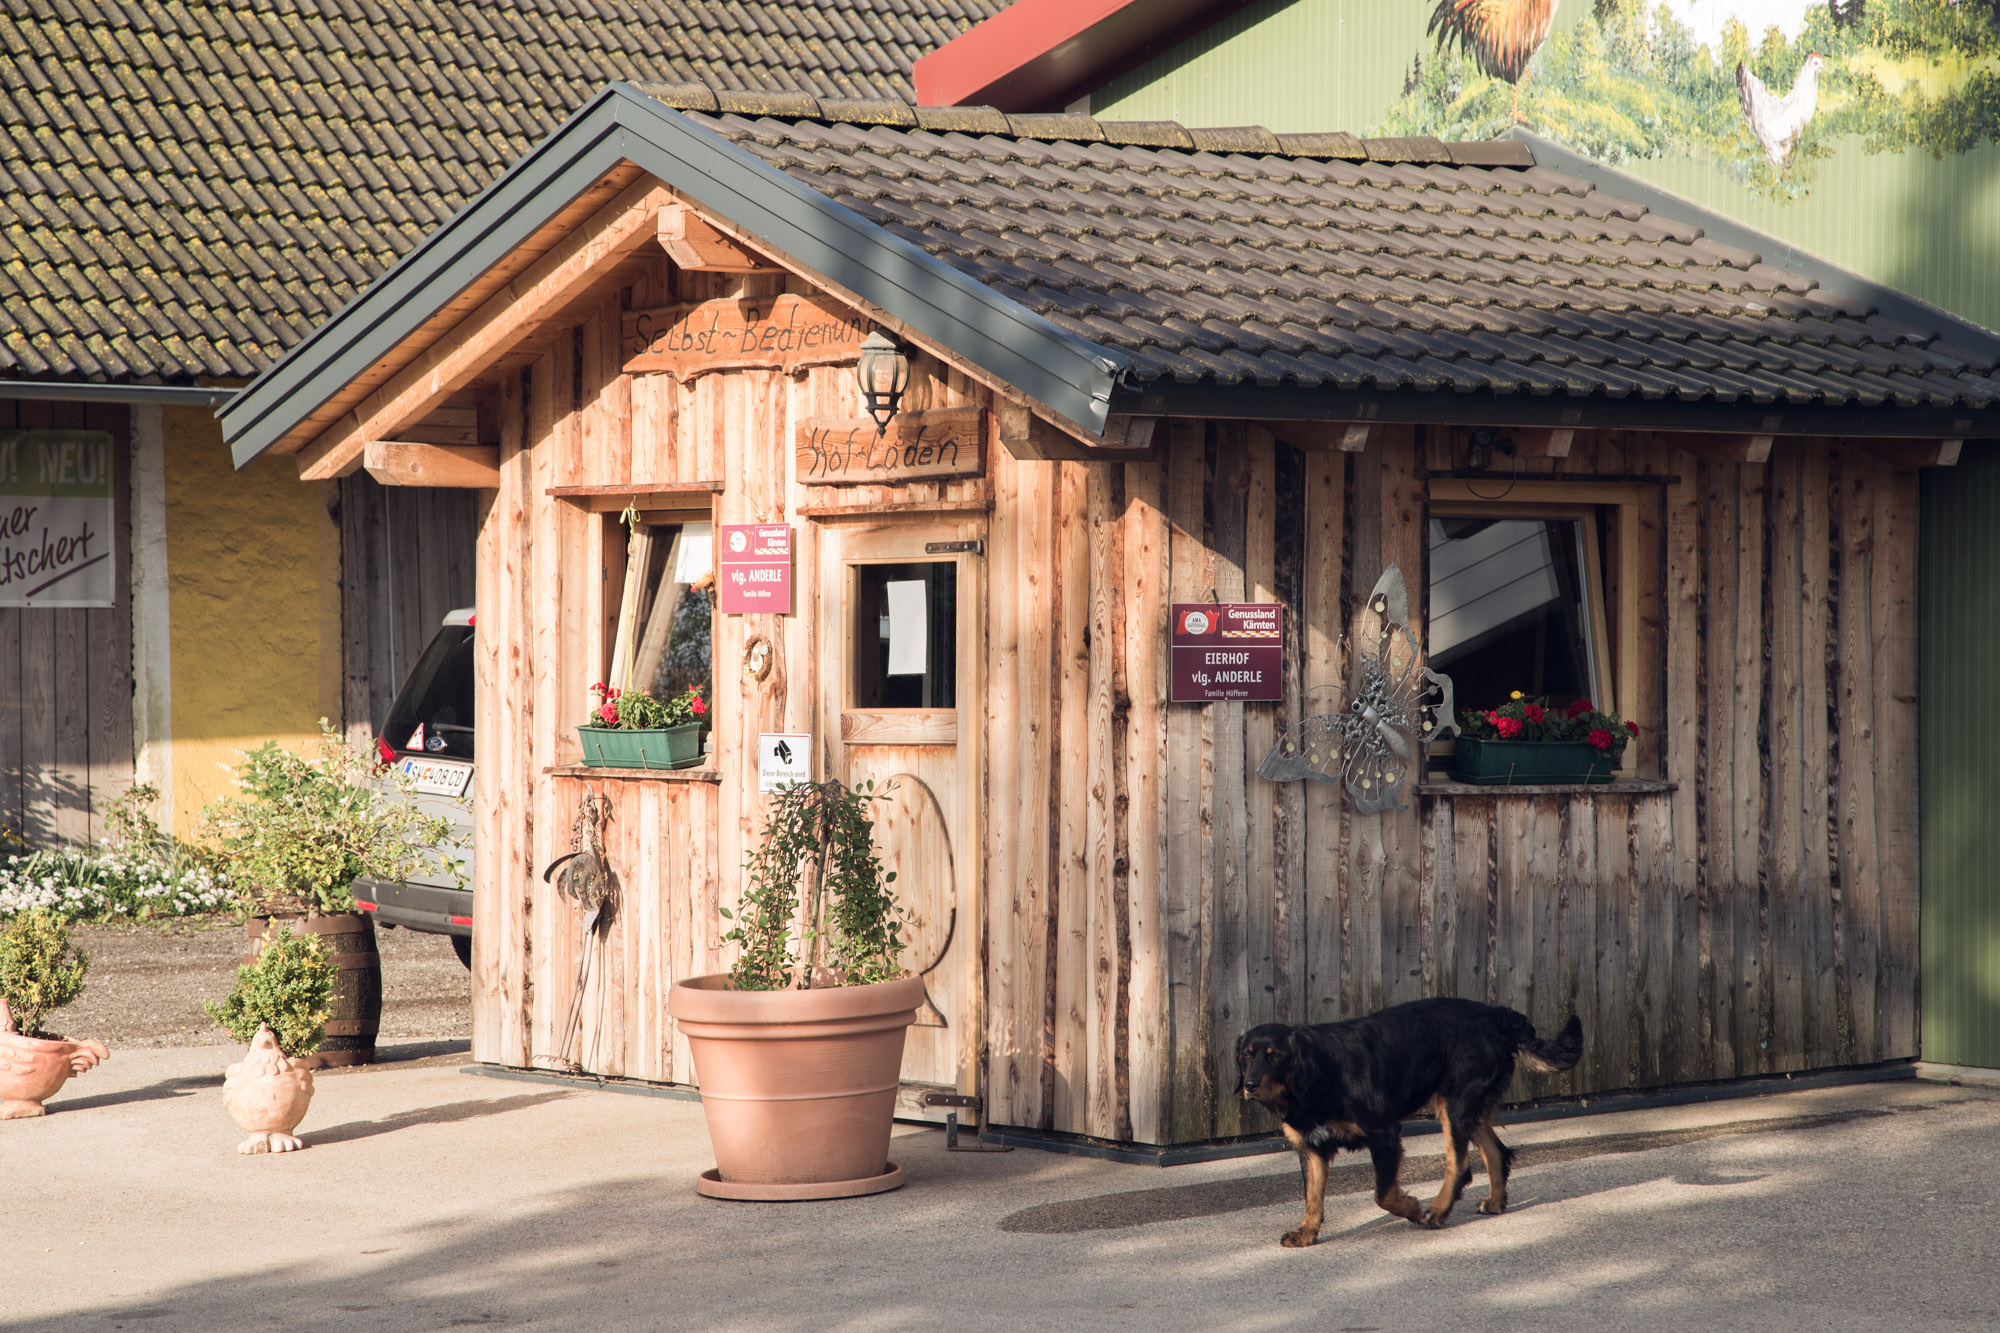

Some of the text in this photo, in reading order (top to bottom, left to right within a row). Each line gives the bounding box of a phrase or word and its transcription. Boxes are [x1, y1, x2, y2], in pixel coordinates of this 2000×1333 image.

[38, 442, 105, 485] NEU!
[731, 569, 782, 585] vlg. ANDERLE
[1228, 609, 1275, 619] Genussland
[1243, 620, 1275, 629] Kärnten
[1205, 652, 1249, 665] EIERHOF
[1192, 671, 1262, 686] vlg. ANDERLE
[1226, 689, 1248, 697] Höfferer
